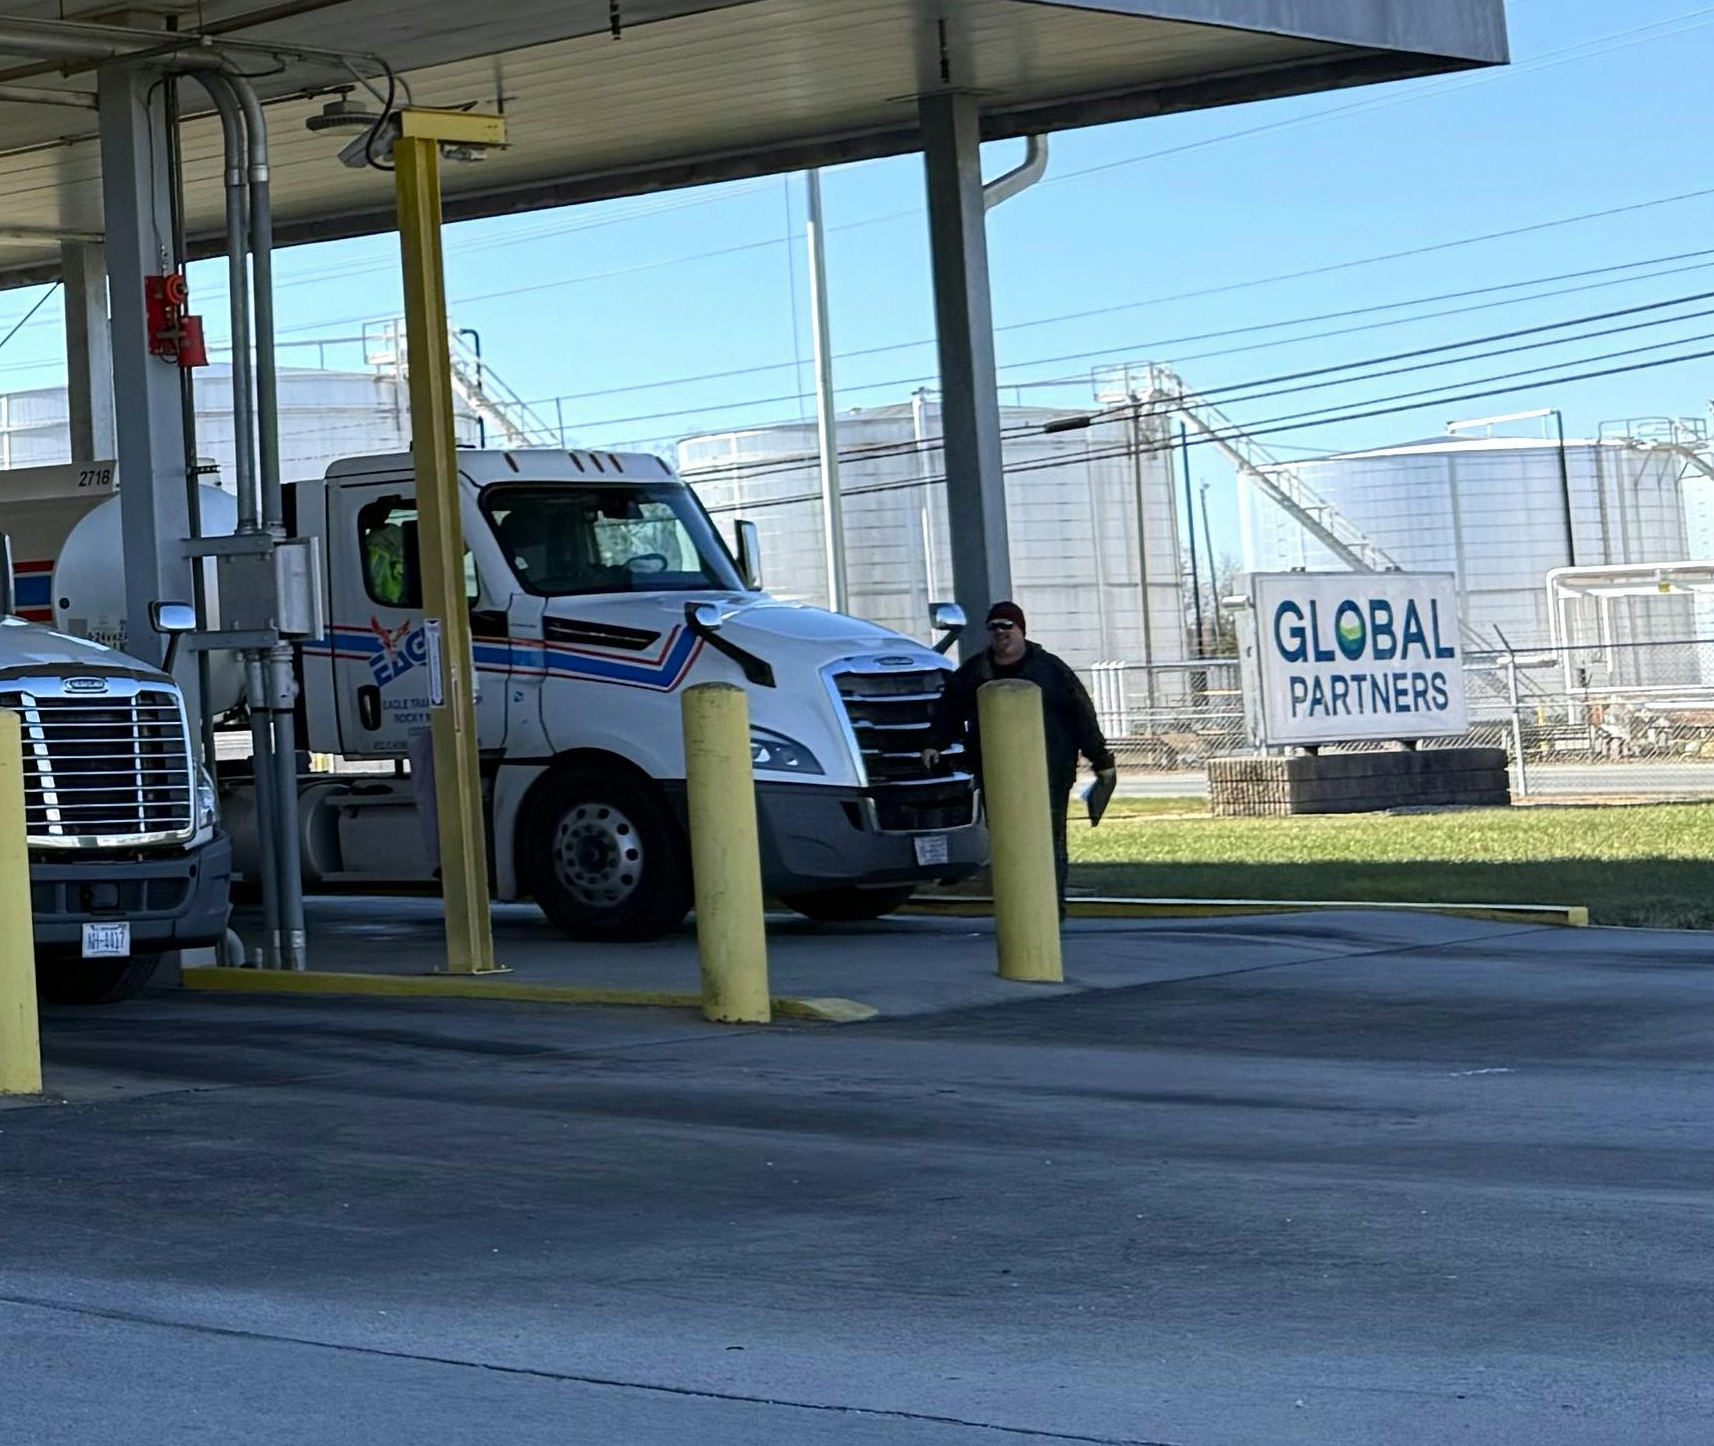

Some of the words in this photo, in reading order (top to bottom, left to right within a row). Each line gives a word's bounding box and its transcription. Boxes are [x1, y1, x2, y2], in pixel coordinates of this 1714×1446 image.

[77, 469, 110, 486] 2718
[1274, 598, 1455, 662] GLOBAL
[1289, 671, 1449, 717] PARTNERS
